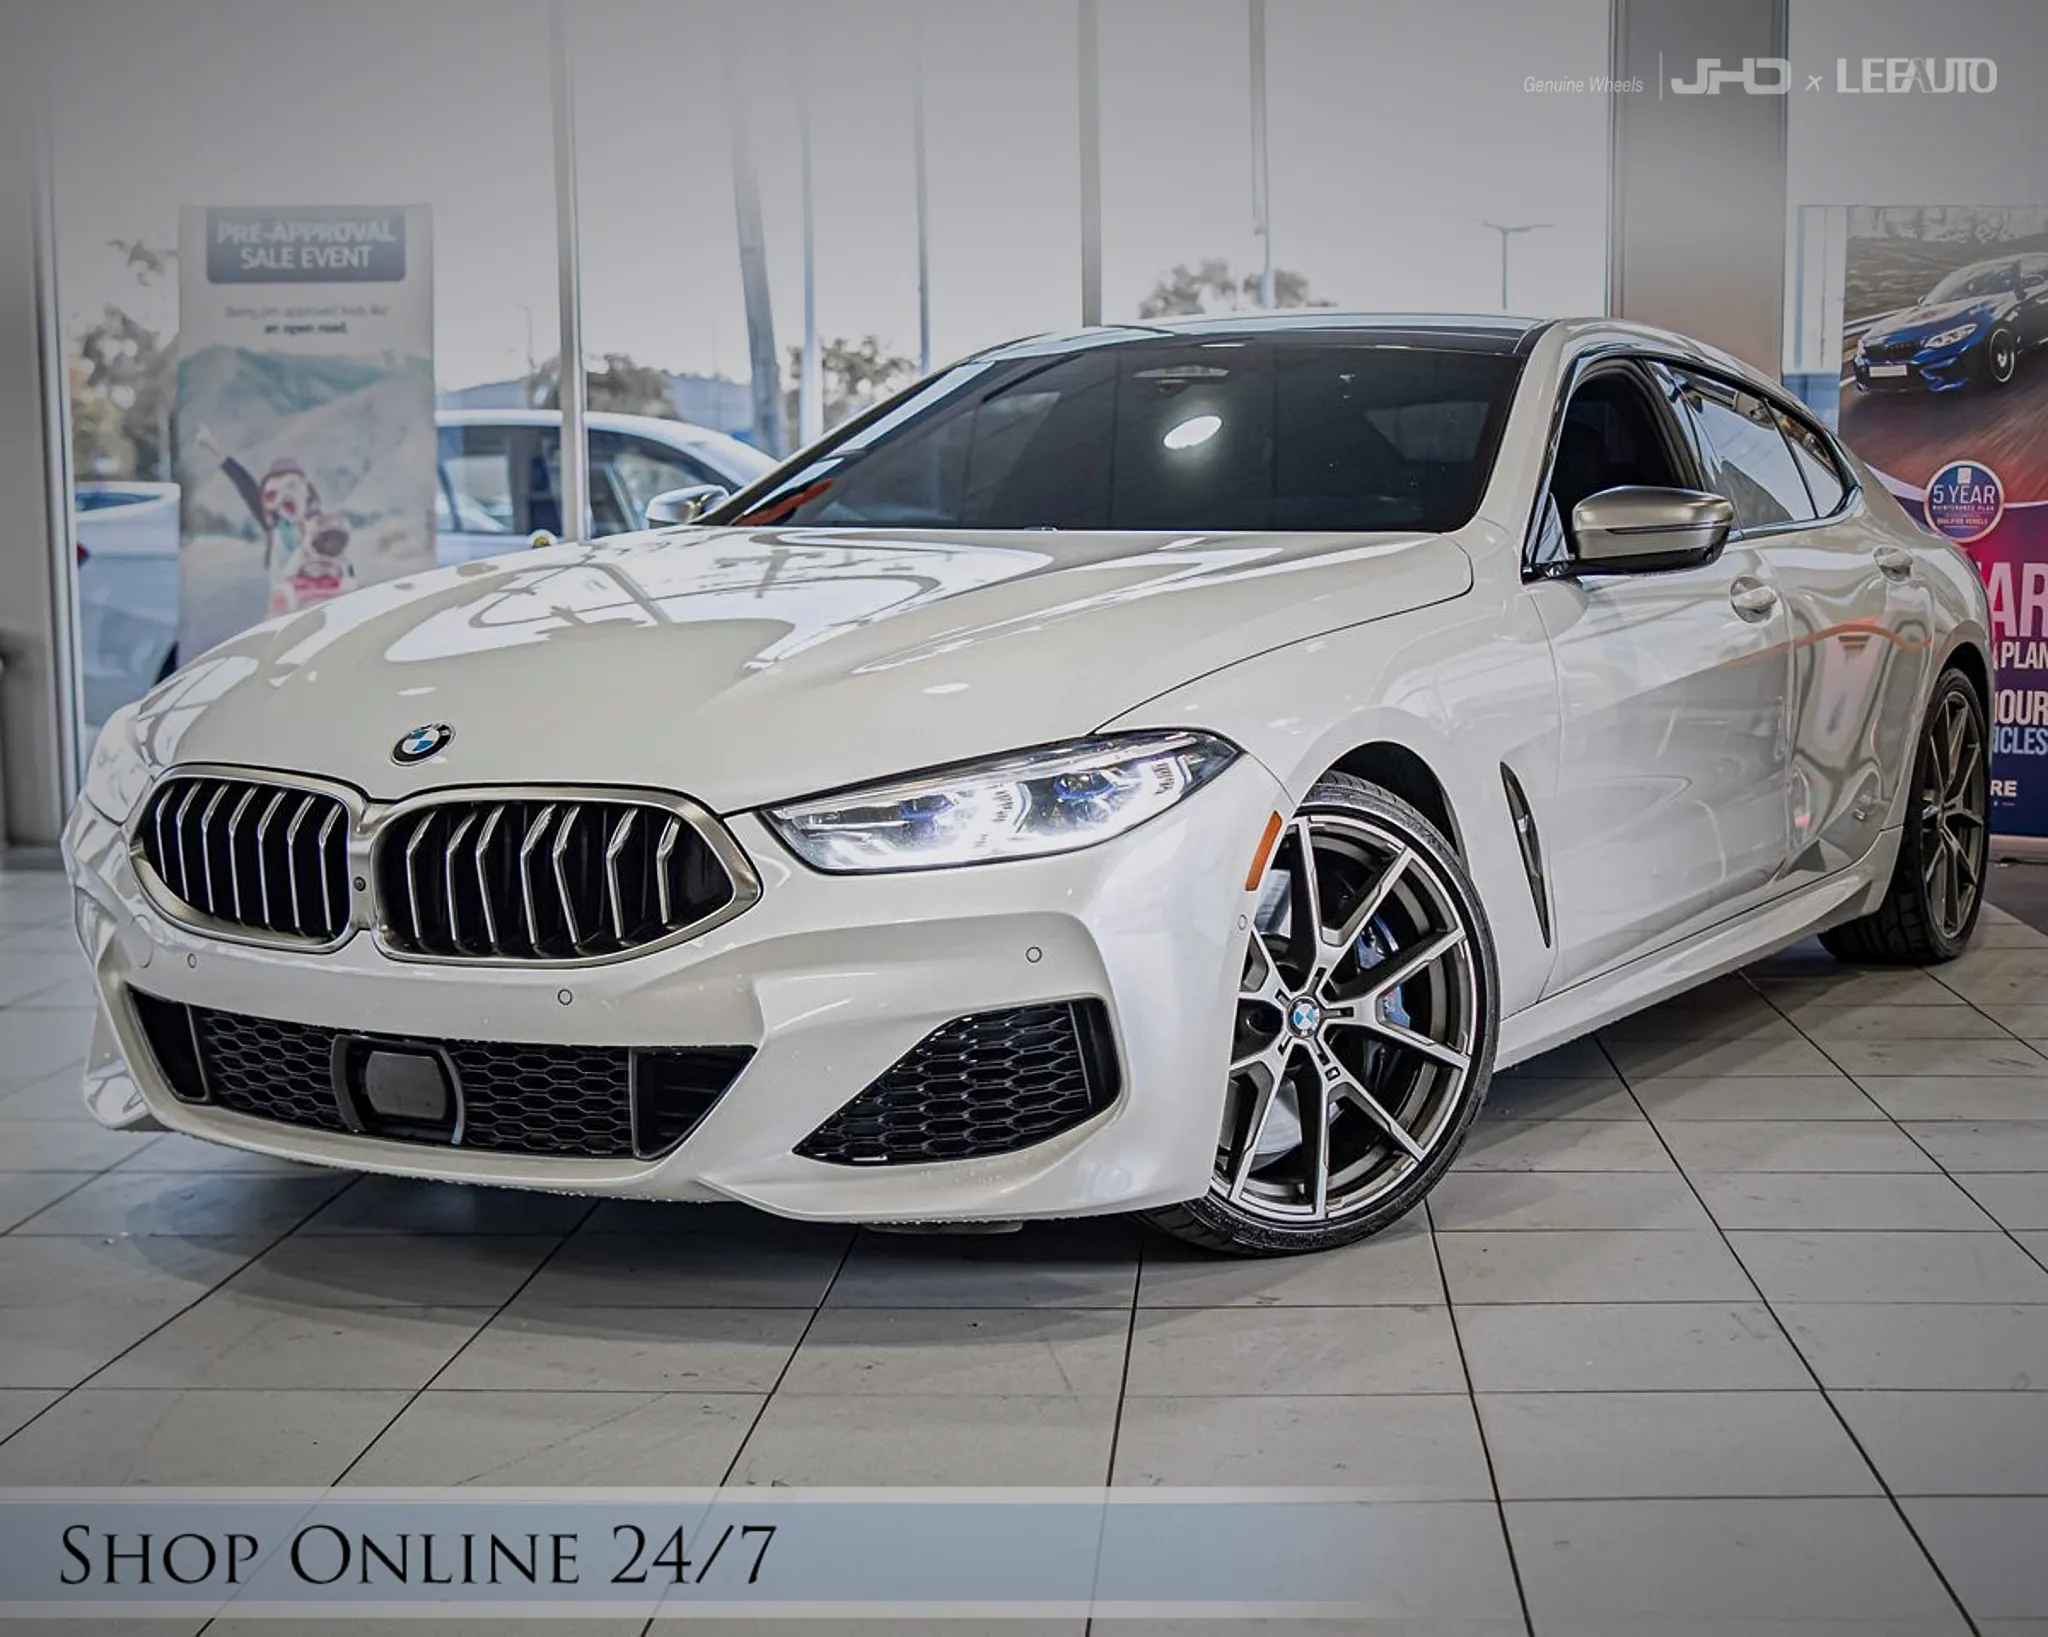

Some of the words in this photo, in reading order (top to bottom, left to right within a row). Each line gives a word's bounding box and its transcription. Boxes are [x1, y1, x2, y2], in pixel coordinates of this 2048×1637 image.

[215, 220, 397, 245] PRE-APPROVAL
[240, 247, 296, 270] SALE
[301, 246, 373, 269] EVENT
[1932, 484, 1945, 504] 5
[1947, 484, 1996, 505] YEAR
[1976, 561, 2048, 638] AR
[1993, 726, 2048, 755] ICLES
